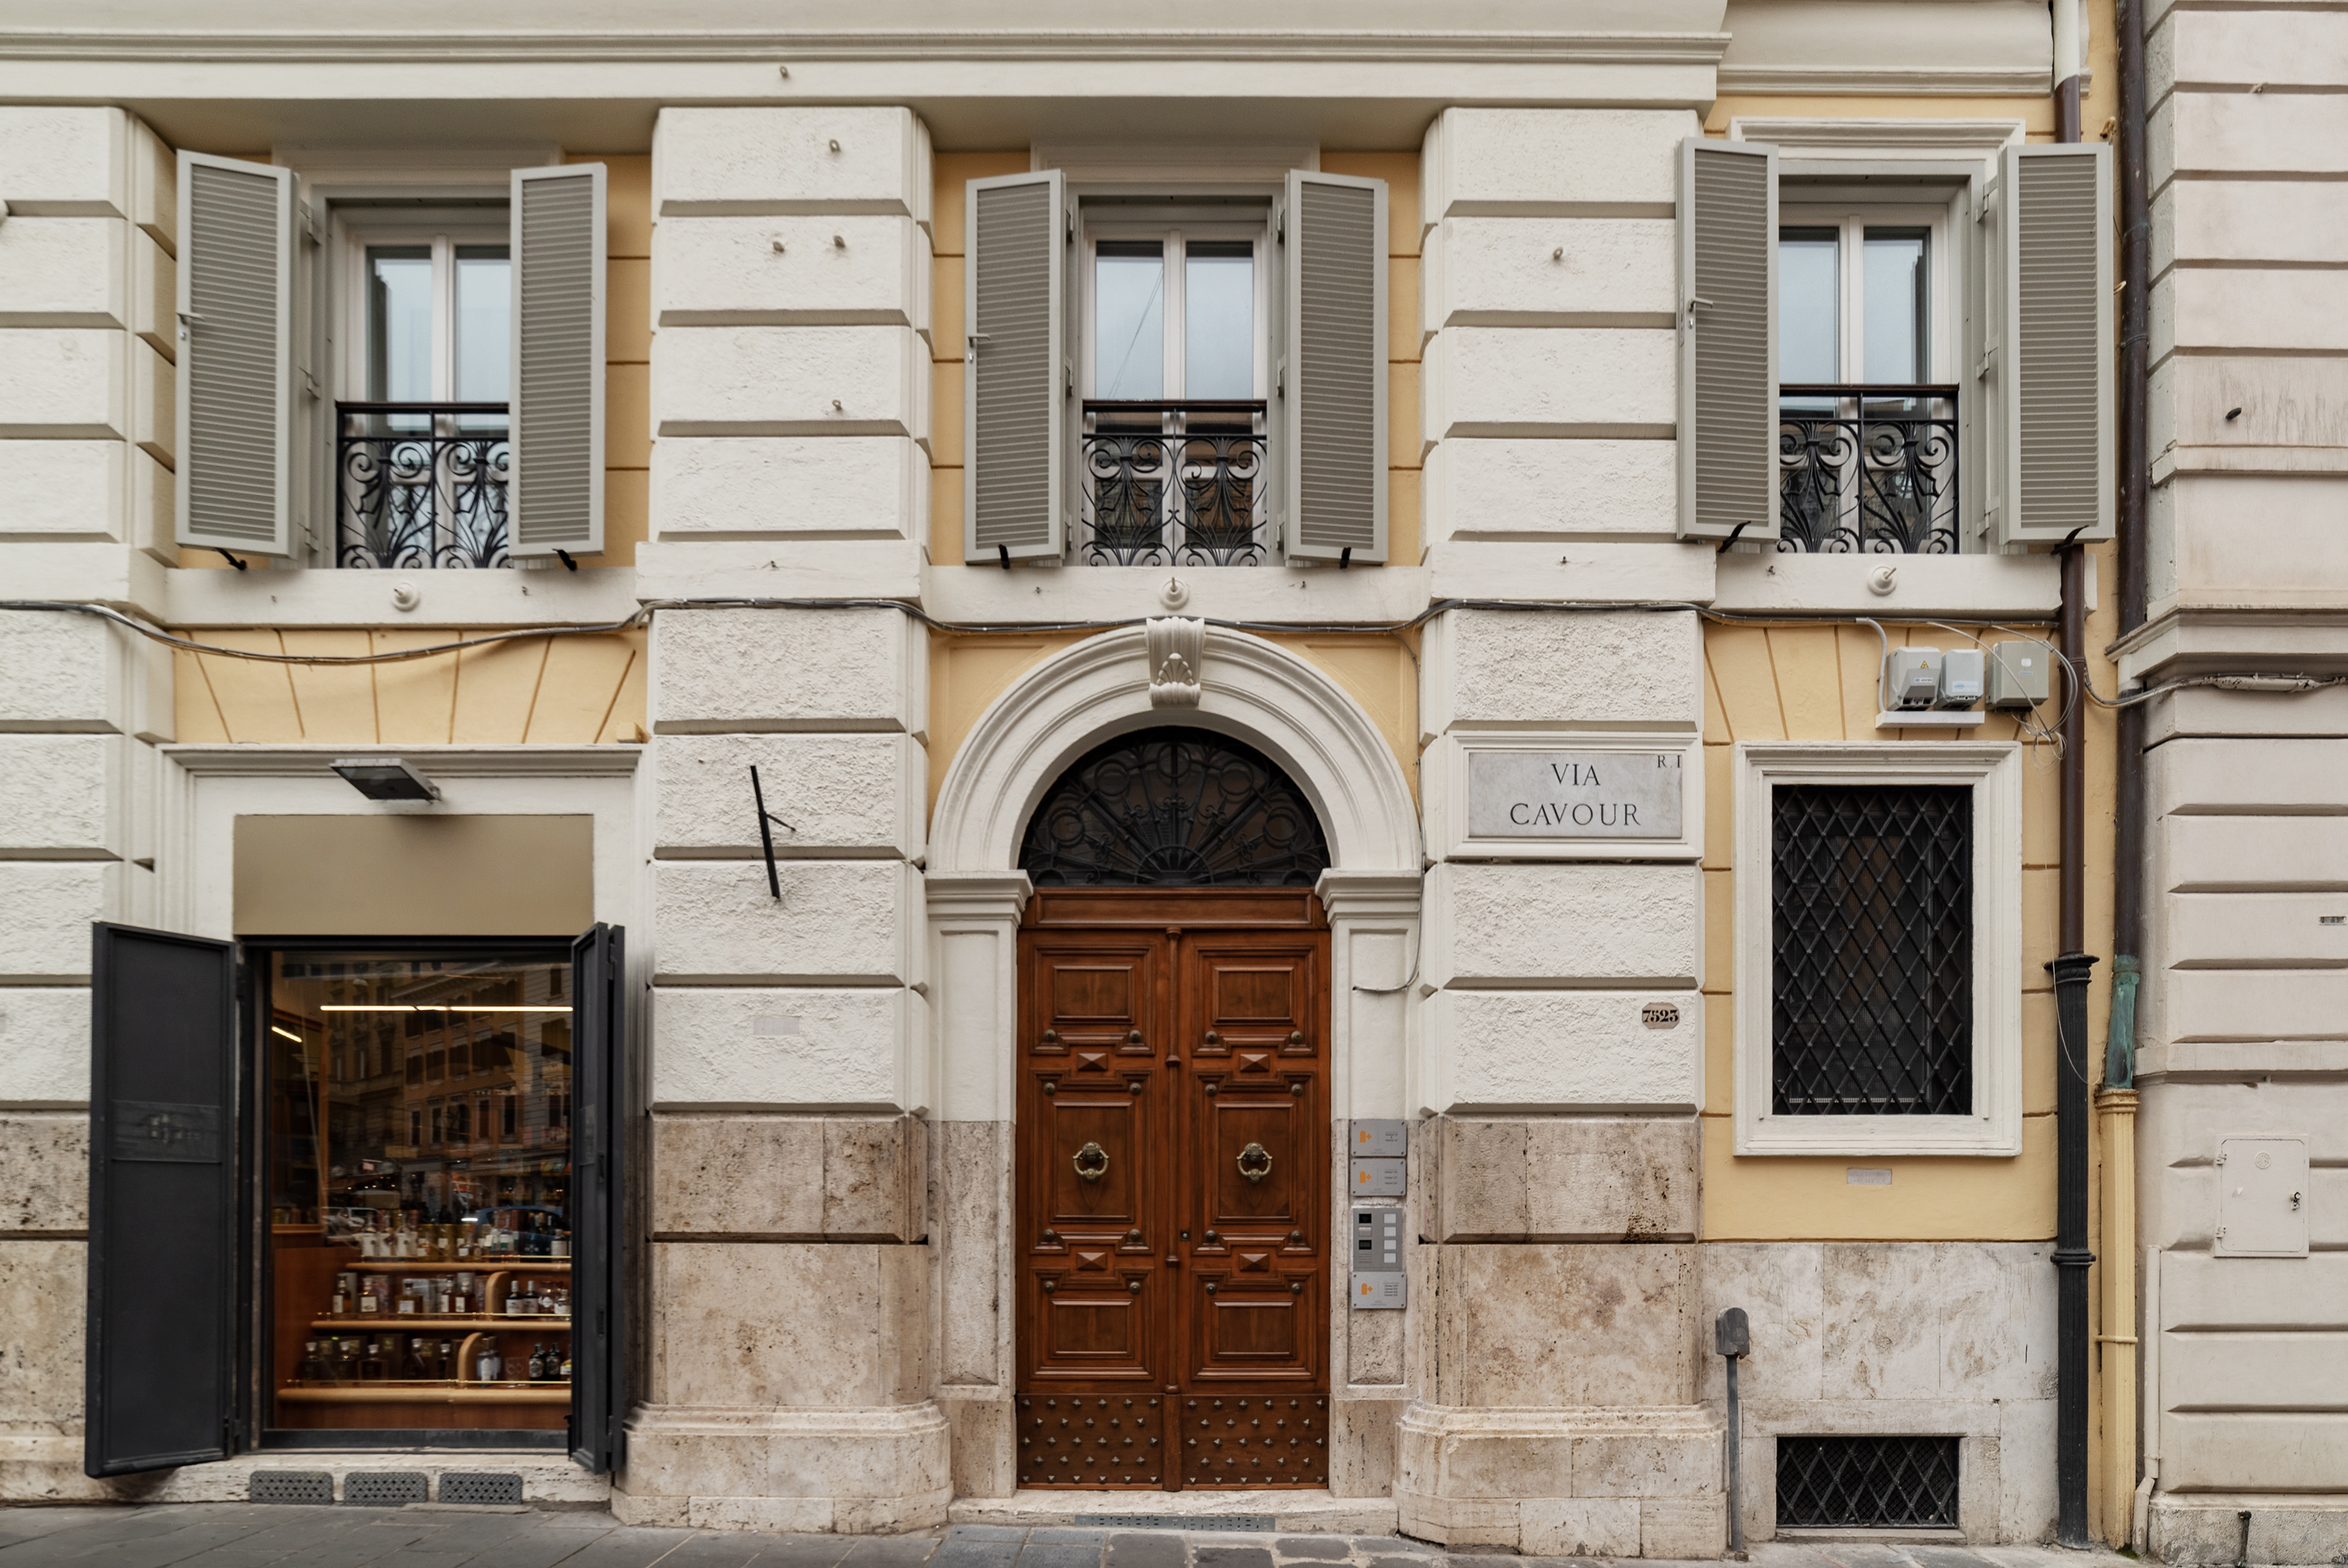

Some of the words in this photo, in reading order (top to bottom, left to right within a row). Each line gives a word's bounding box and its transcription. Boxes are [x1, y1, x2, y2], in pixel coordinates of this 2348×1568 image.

[1551, 763, 1600, 786] VIA
[1510, 803, 1641, 826] CAVOUR
[1642, 1009, 1679, 1023] 7523
